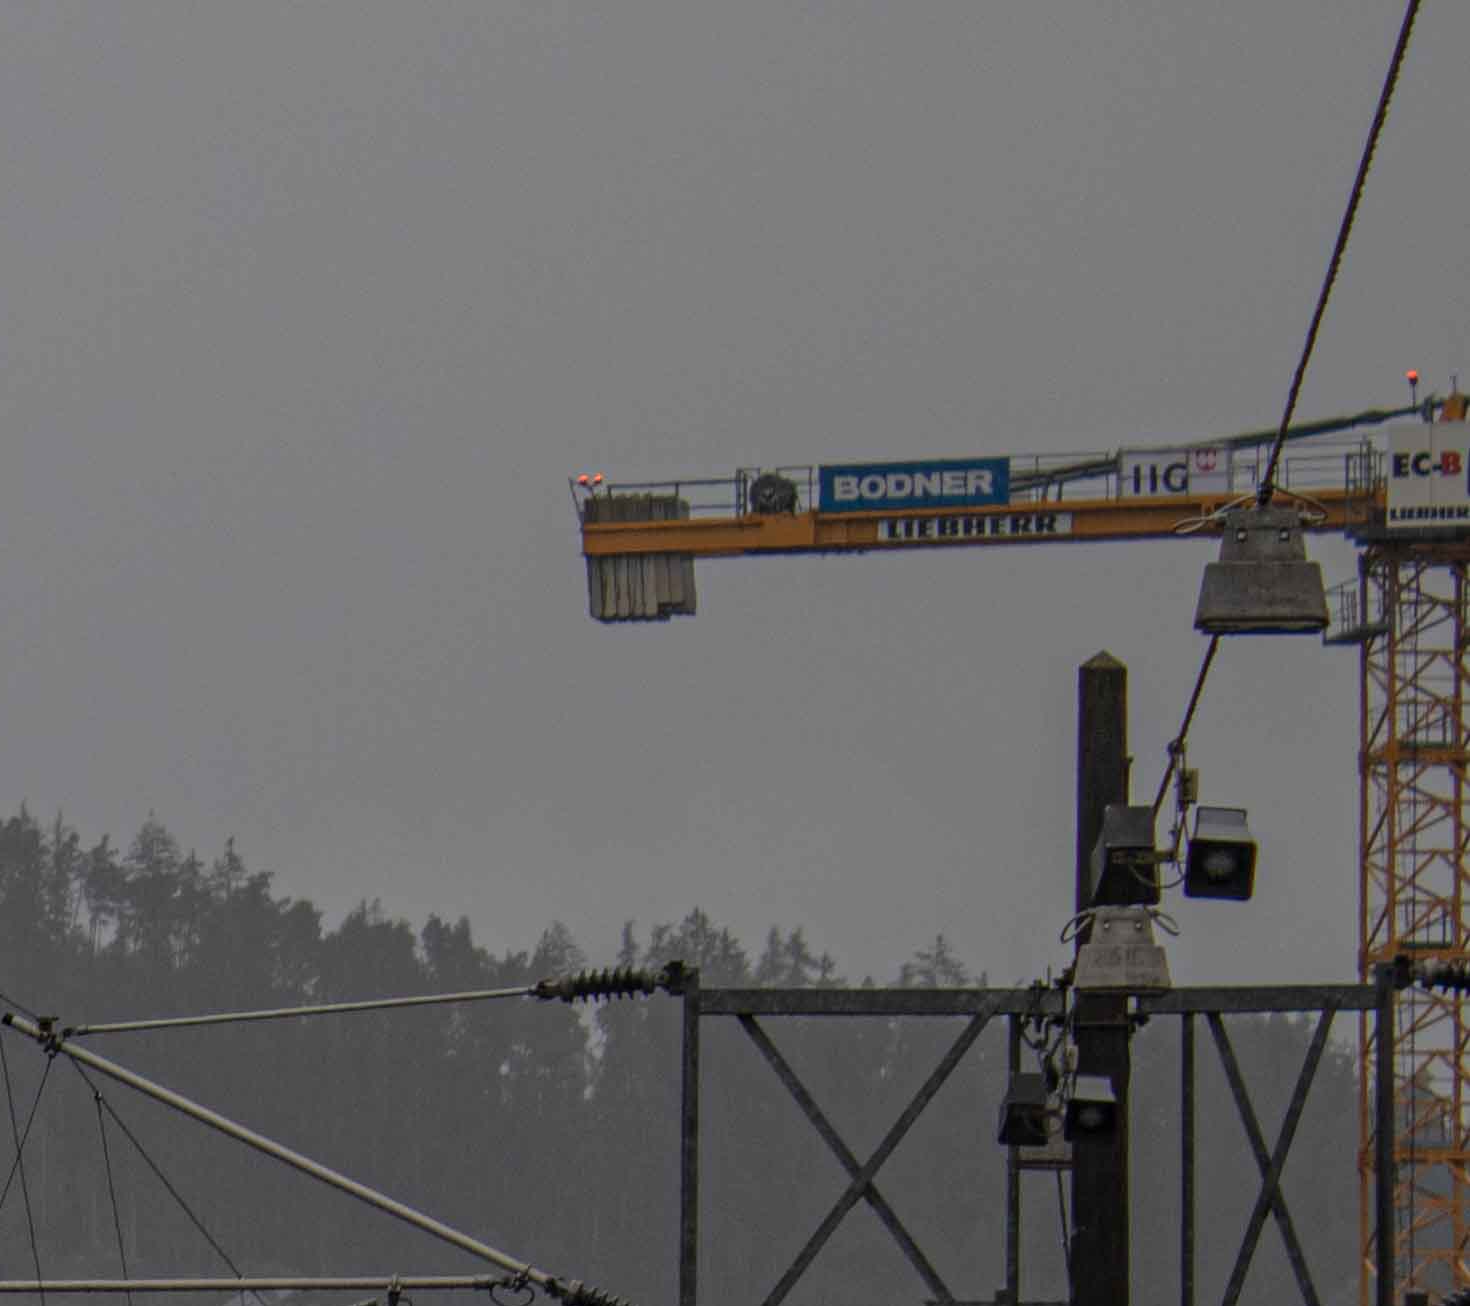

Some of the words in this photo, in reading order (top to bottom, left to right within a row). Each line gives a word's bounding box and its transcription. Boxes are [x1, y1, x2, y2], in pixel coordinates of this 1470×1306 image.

[1393, 452, 1462, 478] EC-B
[833, 468, 994, 502] BODNER
[886, 510, 1057, 538] LIEBHERR
